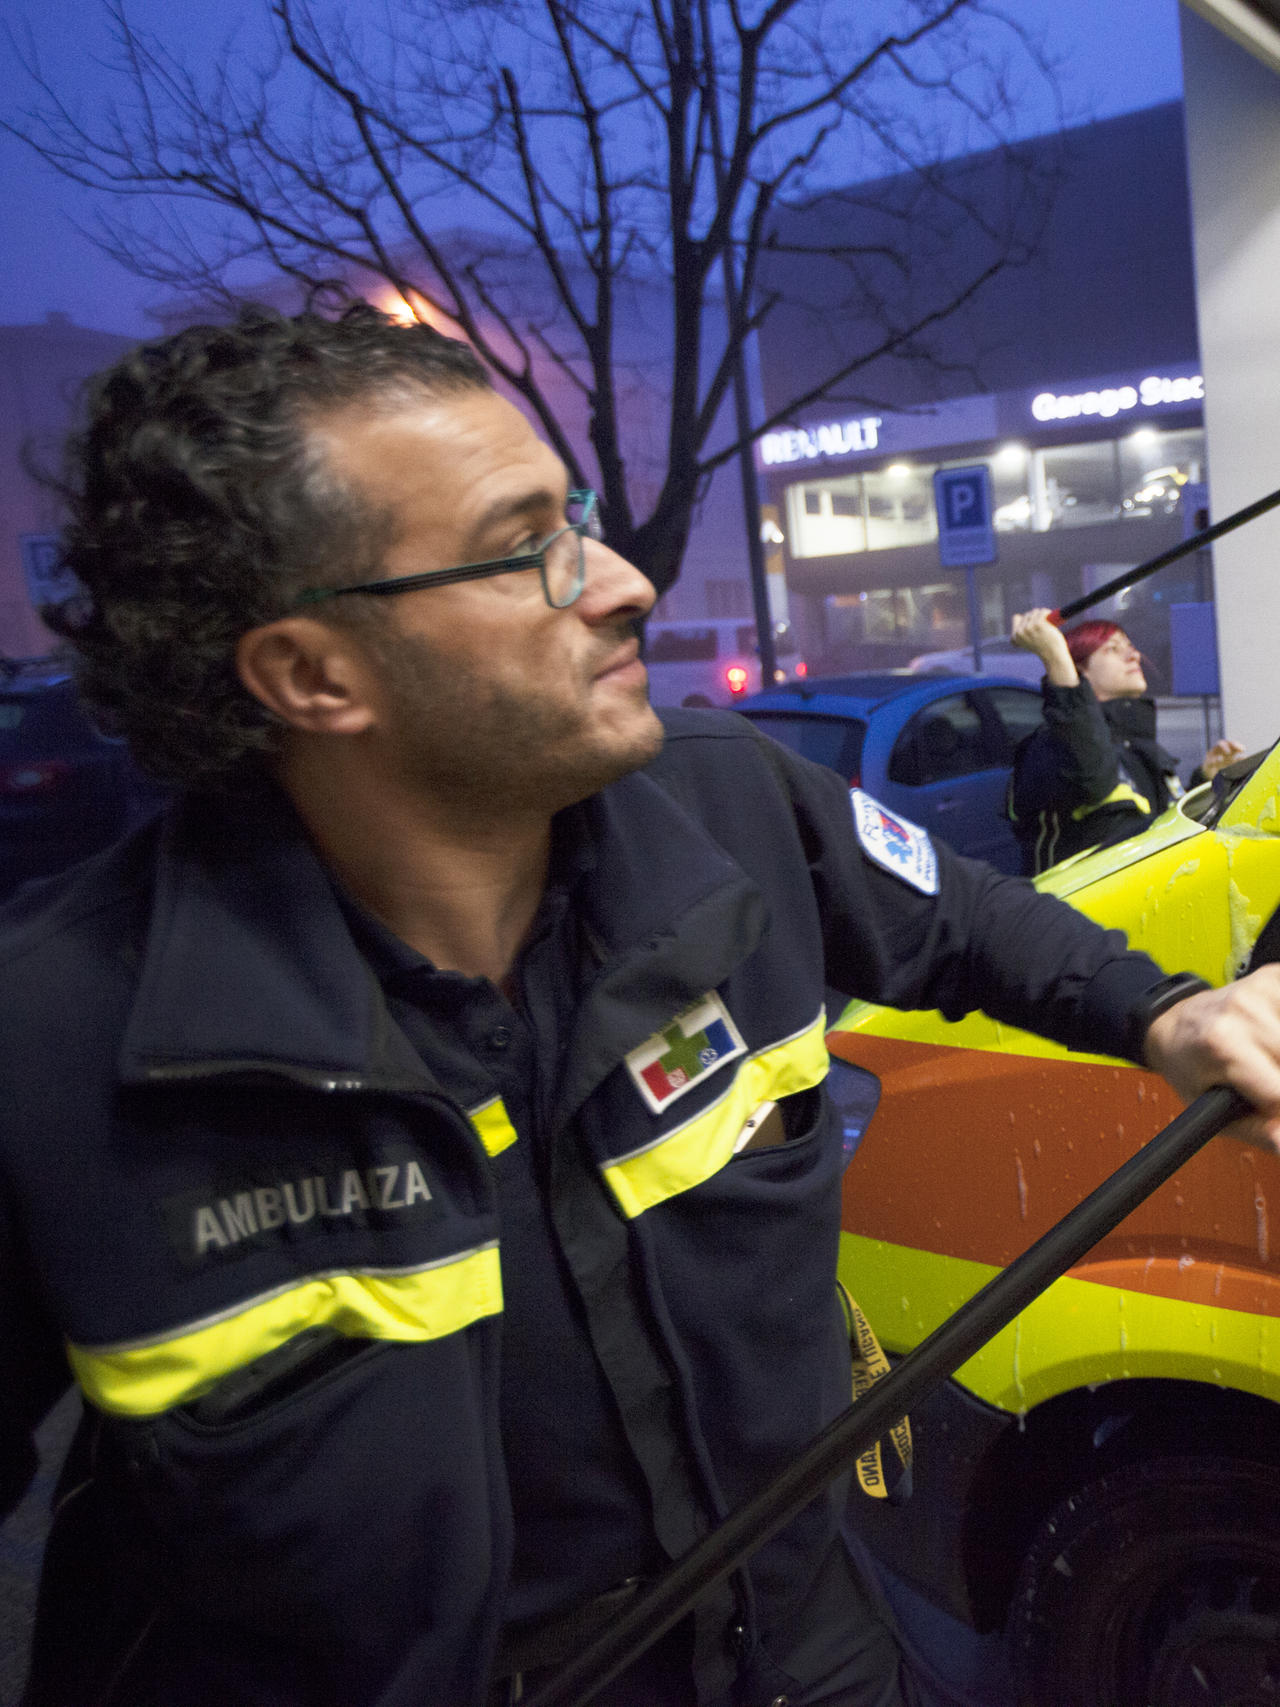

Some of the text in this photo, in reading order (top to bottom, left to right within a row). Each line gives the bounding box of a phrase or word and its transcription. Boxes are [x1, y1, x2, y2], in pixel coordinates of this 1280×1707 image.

[1032, 385, 1139, 421] Garage
[952, 484, 975, 523] P
[196, 1160, 433, 1255] AMBULAZA
